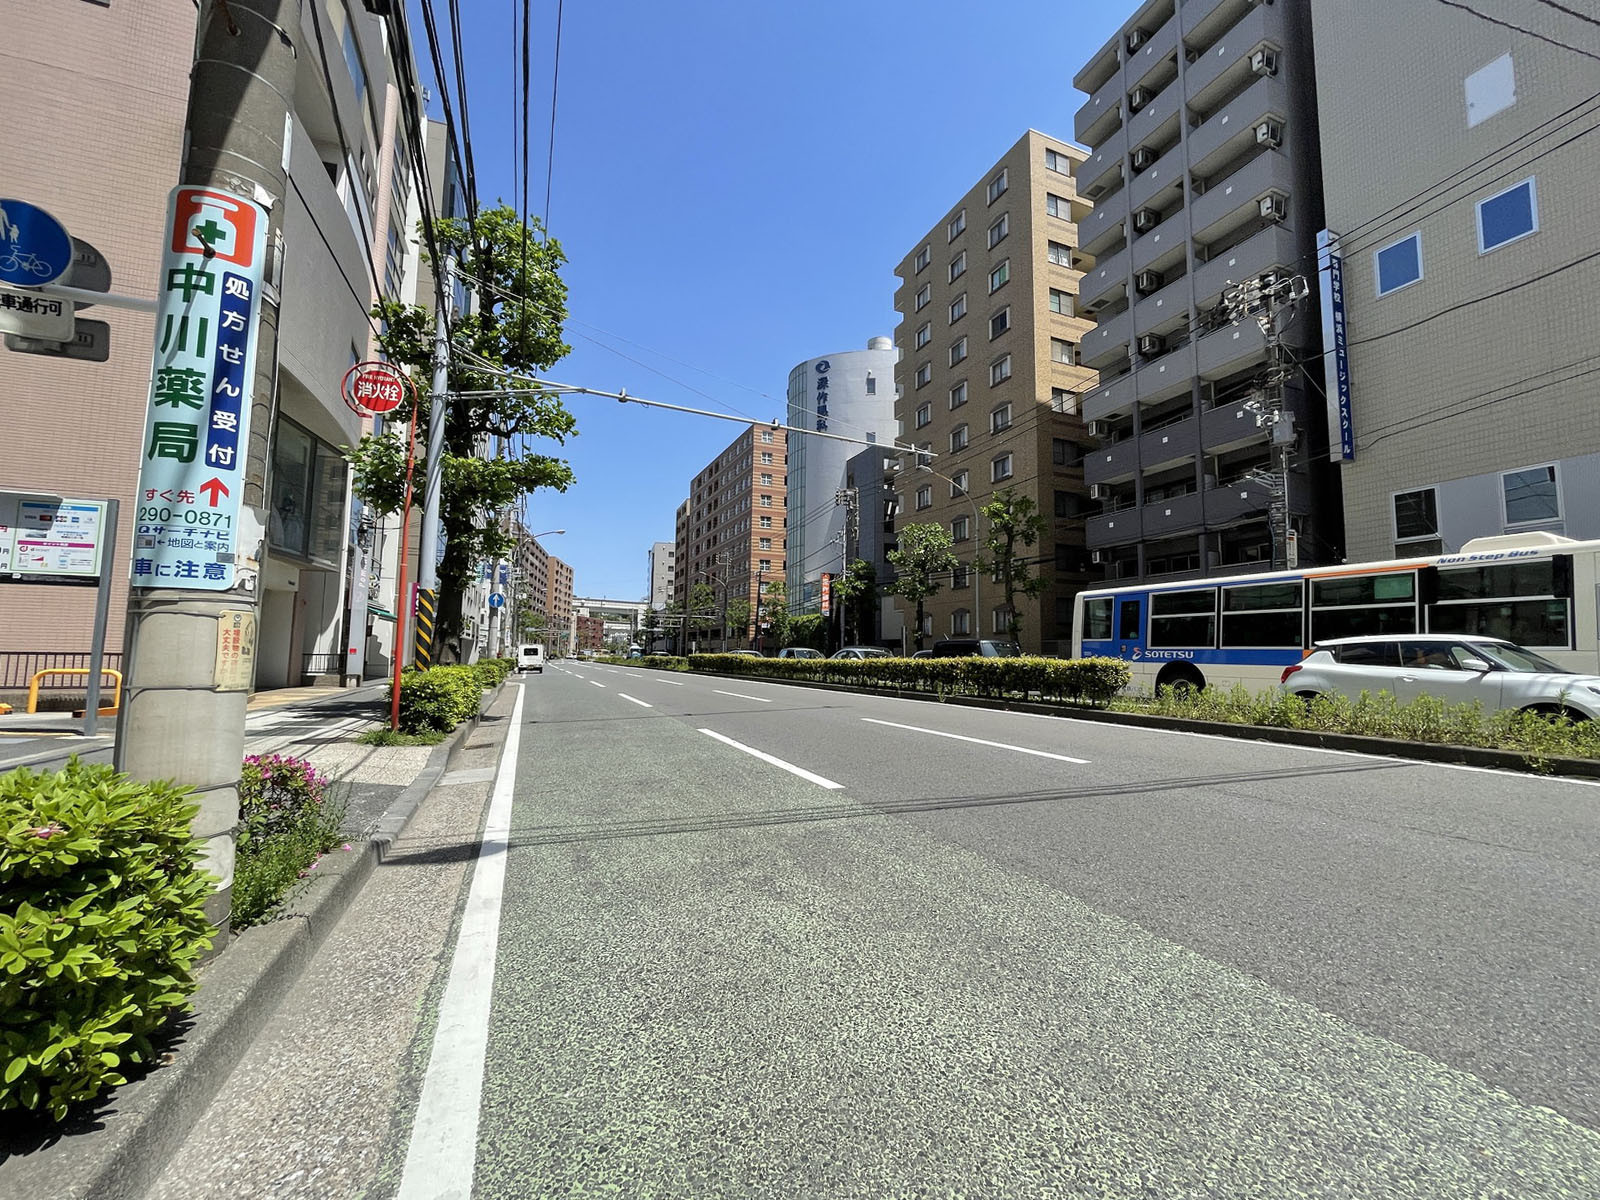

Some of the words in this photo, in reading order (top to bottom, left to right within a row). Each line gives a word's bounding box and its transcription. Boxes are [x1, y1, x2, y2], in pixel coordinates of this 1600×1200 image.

[148, 264, 217, 464] 中川薬局
[208, 275, 250, 466] 処方せん受付
[357, 381, 399, 402] 消火栓
[145, 488, 195, 504] すぐ先
[138, 507, 232, 528] 290-0871
[167, 537, 230, 552] 地図と案内
[1469, 552, 1505, 561] Step
[1507, 550, 1539, 558] Bus
[133, 557, 227, 580] 車に注意
[1144, 650, 1194, 659] SOTETSU
